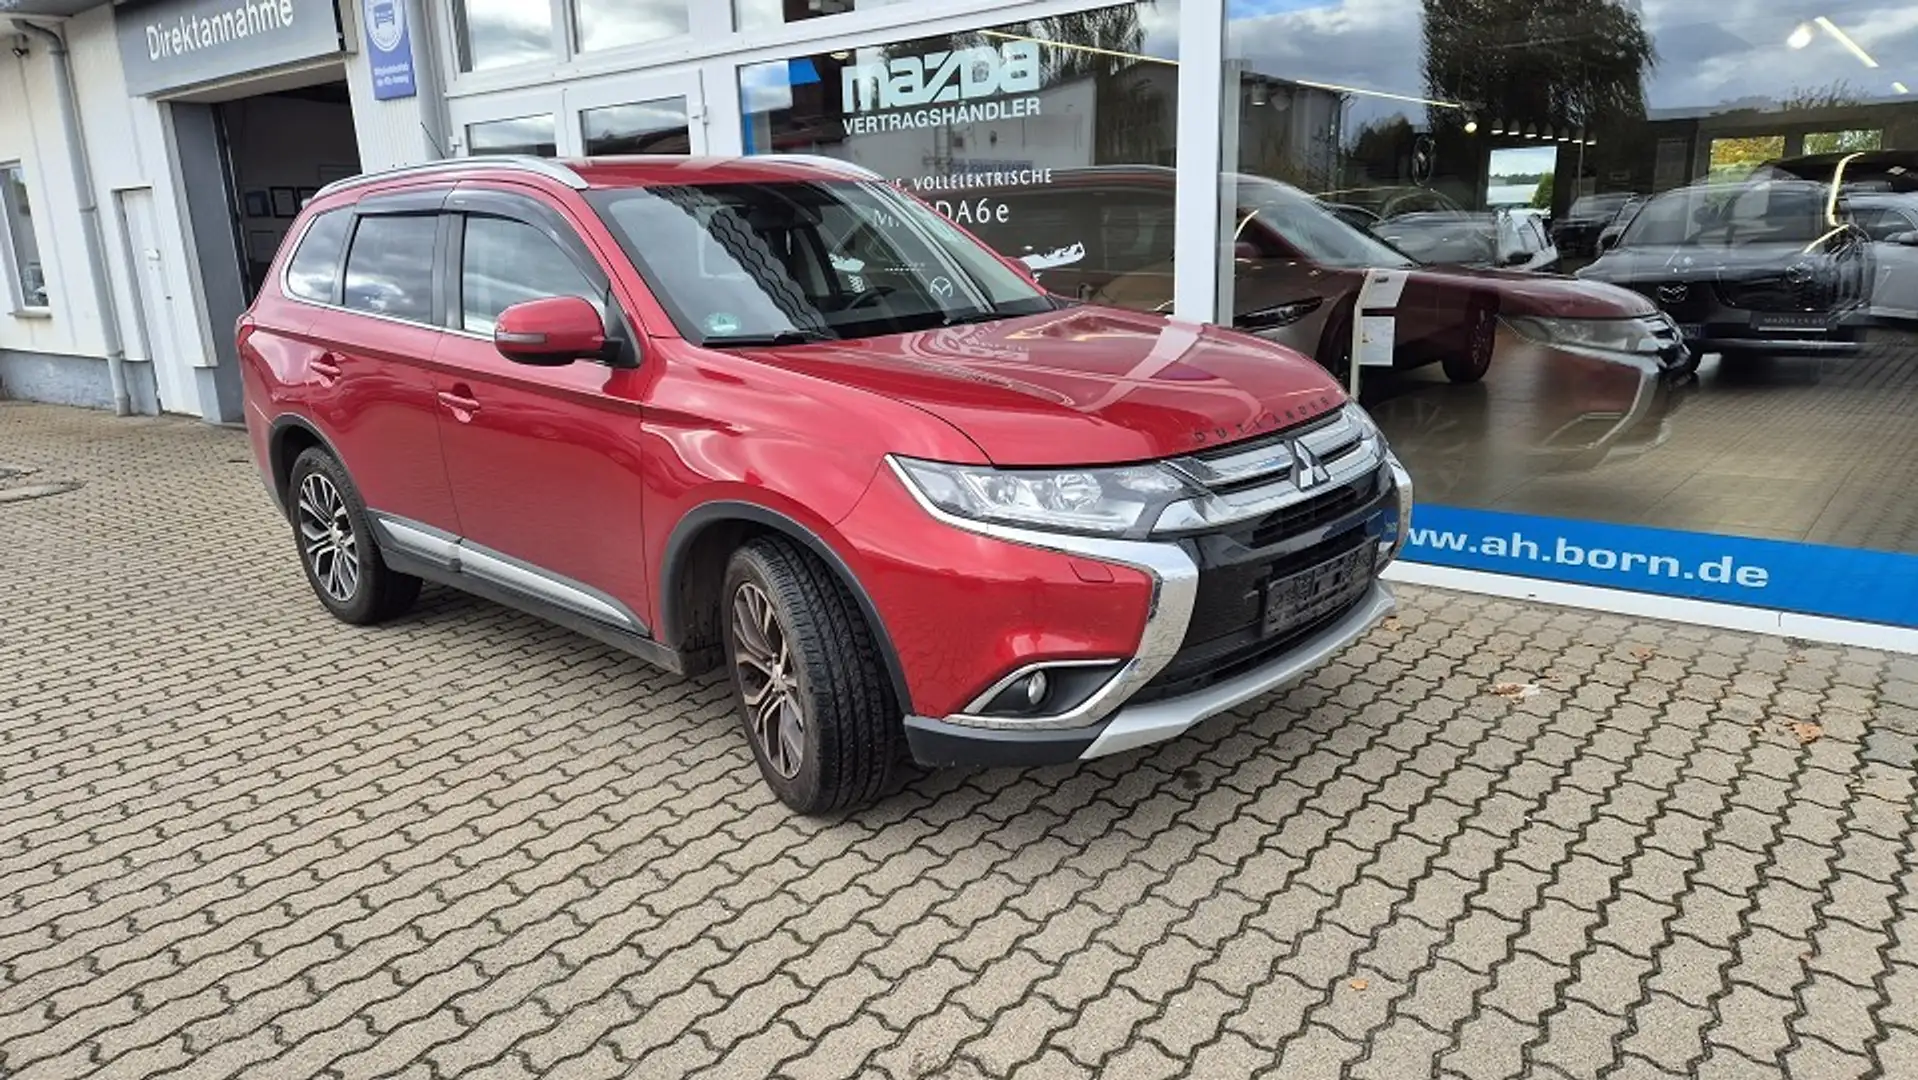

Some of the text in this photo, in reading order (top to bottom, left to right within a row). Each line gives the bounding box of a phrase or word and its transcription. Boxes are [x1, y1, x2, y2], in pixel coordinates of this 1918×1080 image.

[146, 0, 294, 61] Direktannahme
[842, 97, 1041, 135] VERTRAGSHÄNDLER
[913, 167, 1052, 192] VOLLELEKTRISCHE
[1194, 396, 1330, 443] OUTLANDER
